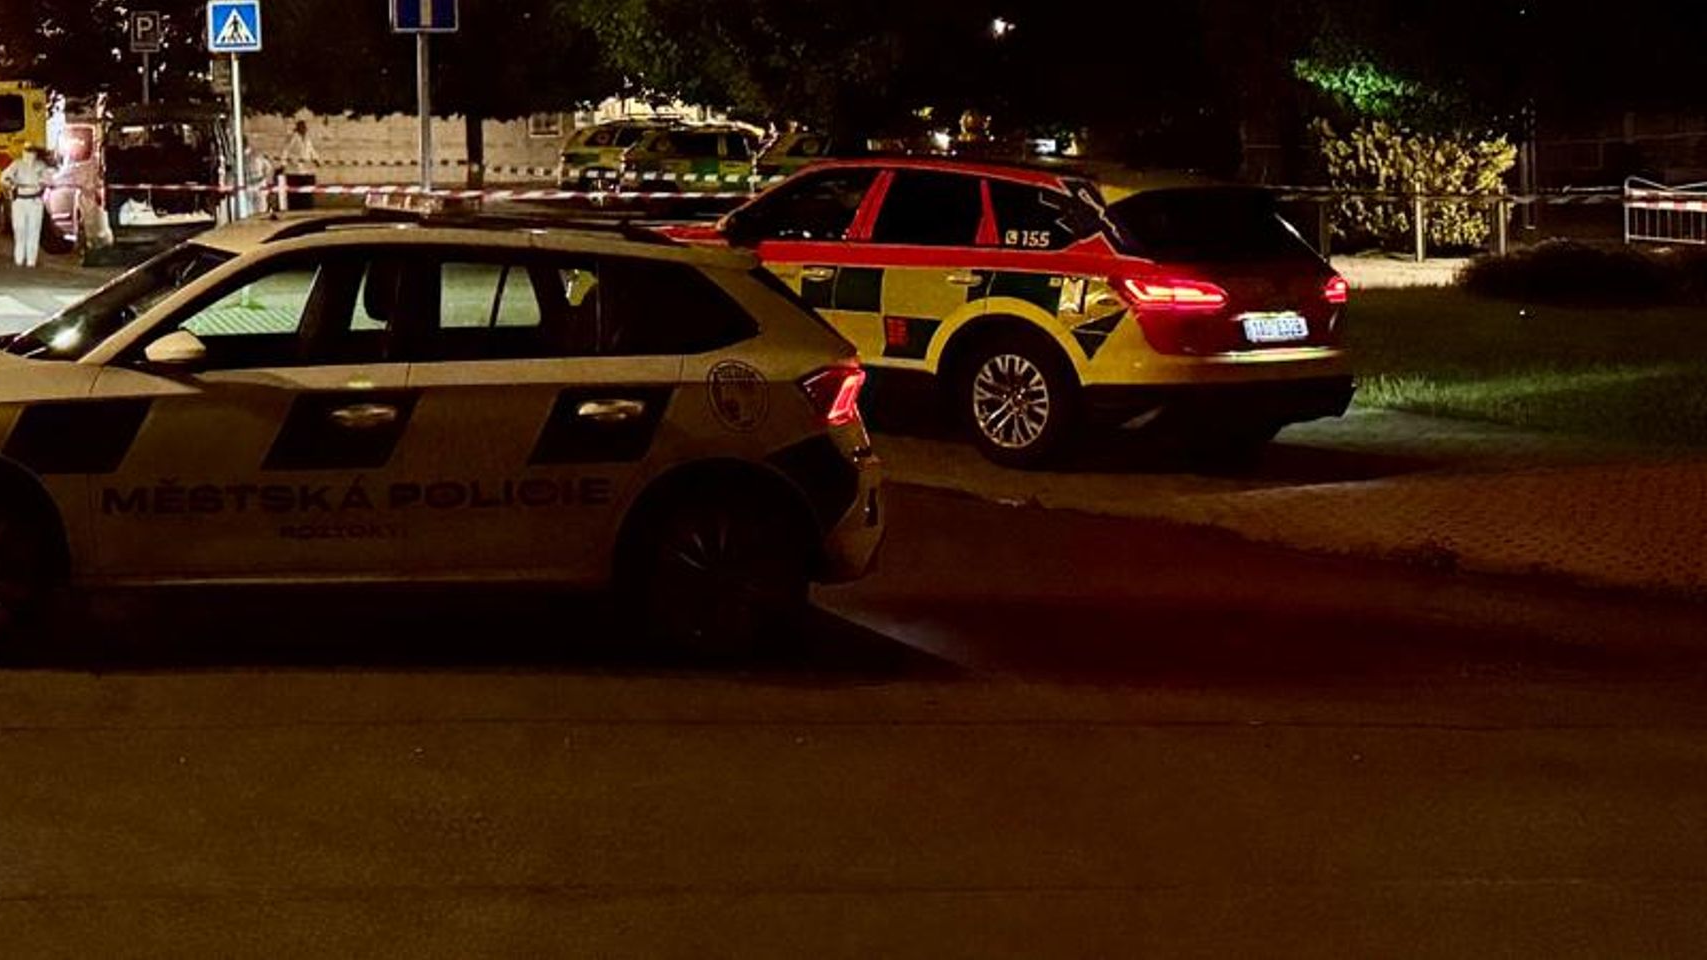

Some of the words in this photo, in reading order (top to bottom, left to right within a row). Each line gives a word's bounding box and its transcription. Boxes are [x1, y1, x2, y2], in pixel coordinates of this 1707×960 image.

[136, 16, 154, 40] P
[1021, 229, 1051, 248] 155
[102, 474, 374, 514] MĚSTSKÁ
[389, 477, 613, 510] POLICIE
